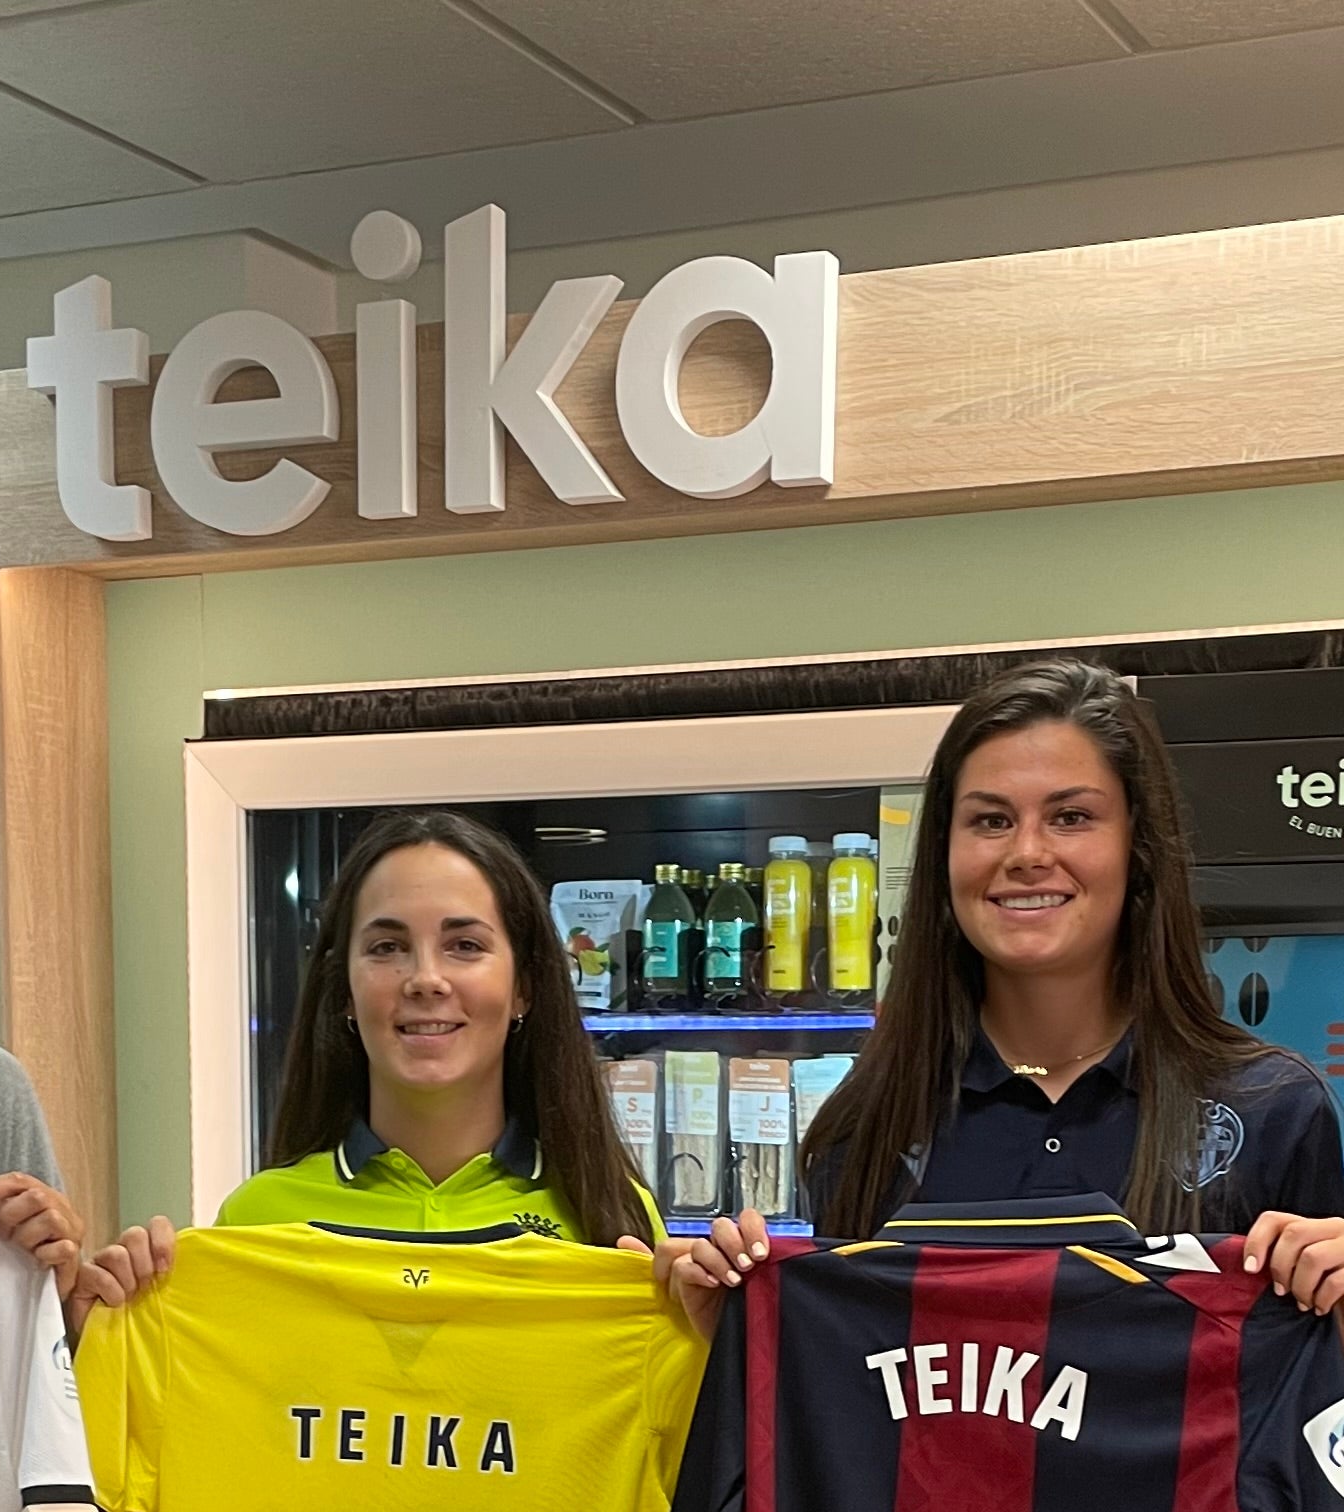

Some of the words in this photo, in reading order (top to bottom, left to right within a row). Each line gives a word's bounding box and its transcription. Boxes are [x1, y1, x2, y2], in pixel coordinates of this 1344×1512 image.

[26, 203, 840, 543] teika
[1288, 815, 1304, 831] EL
[1306, 822, 1343, 839] BUEN
[579, 888, 614, 900] Born
[864, 1342, 1089, 1442] TEIKA
[290, 1406, 515, 1474] TEIKA
